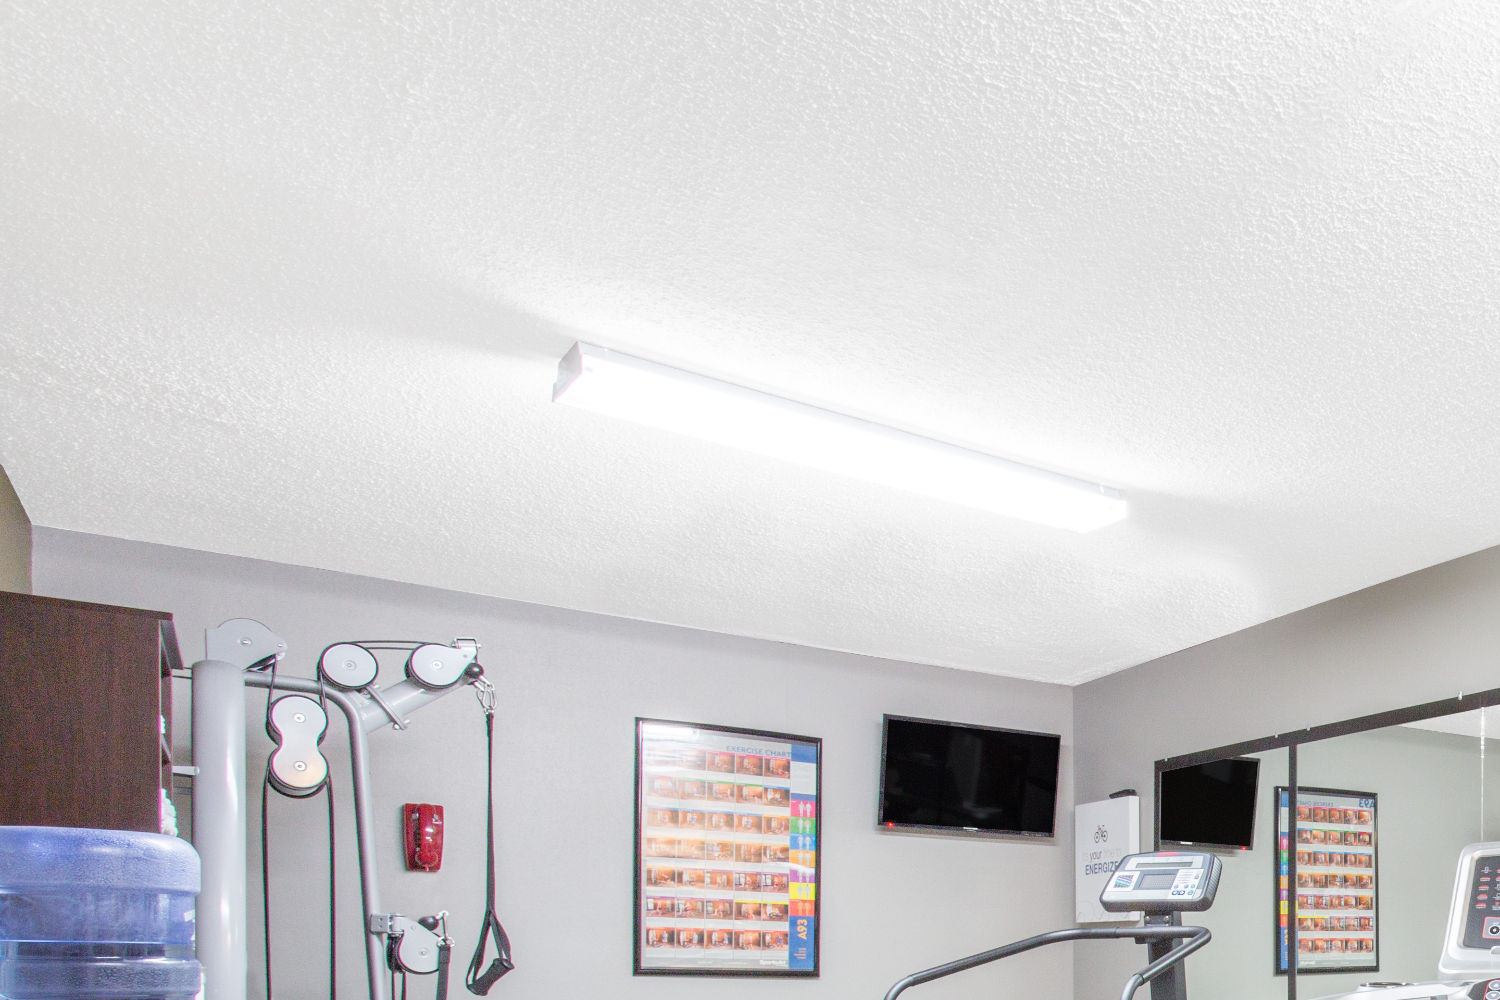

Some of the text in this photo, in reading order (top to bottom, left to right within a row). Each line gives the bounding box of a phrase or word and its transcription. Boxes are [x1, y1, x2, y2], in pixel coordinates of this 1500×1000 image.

[726, 745, 791, 758] EXERCISE CHART
[796, 919, 808, 940] A93
